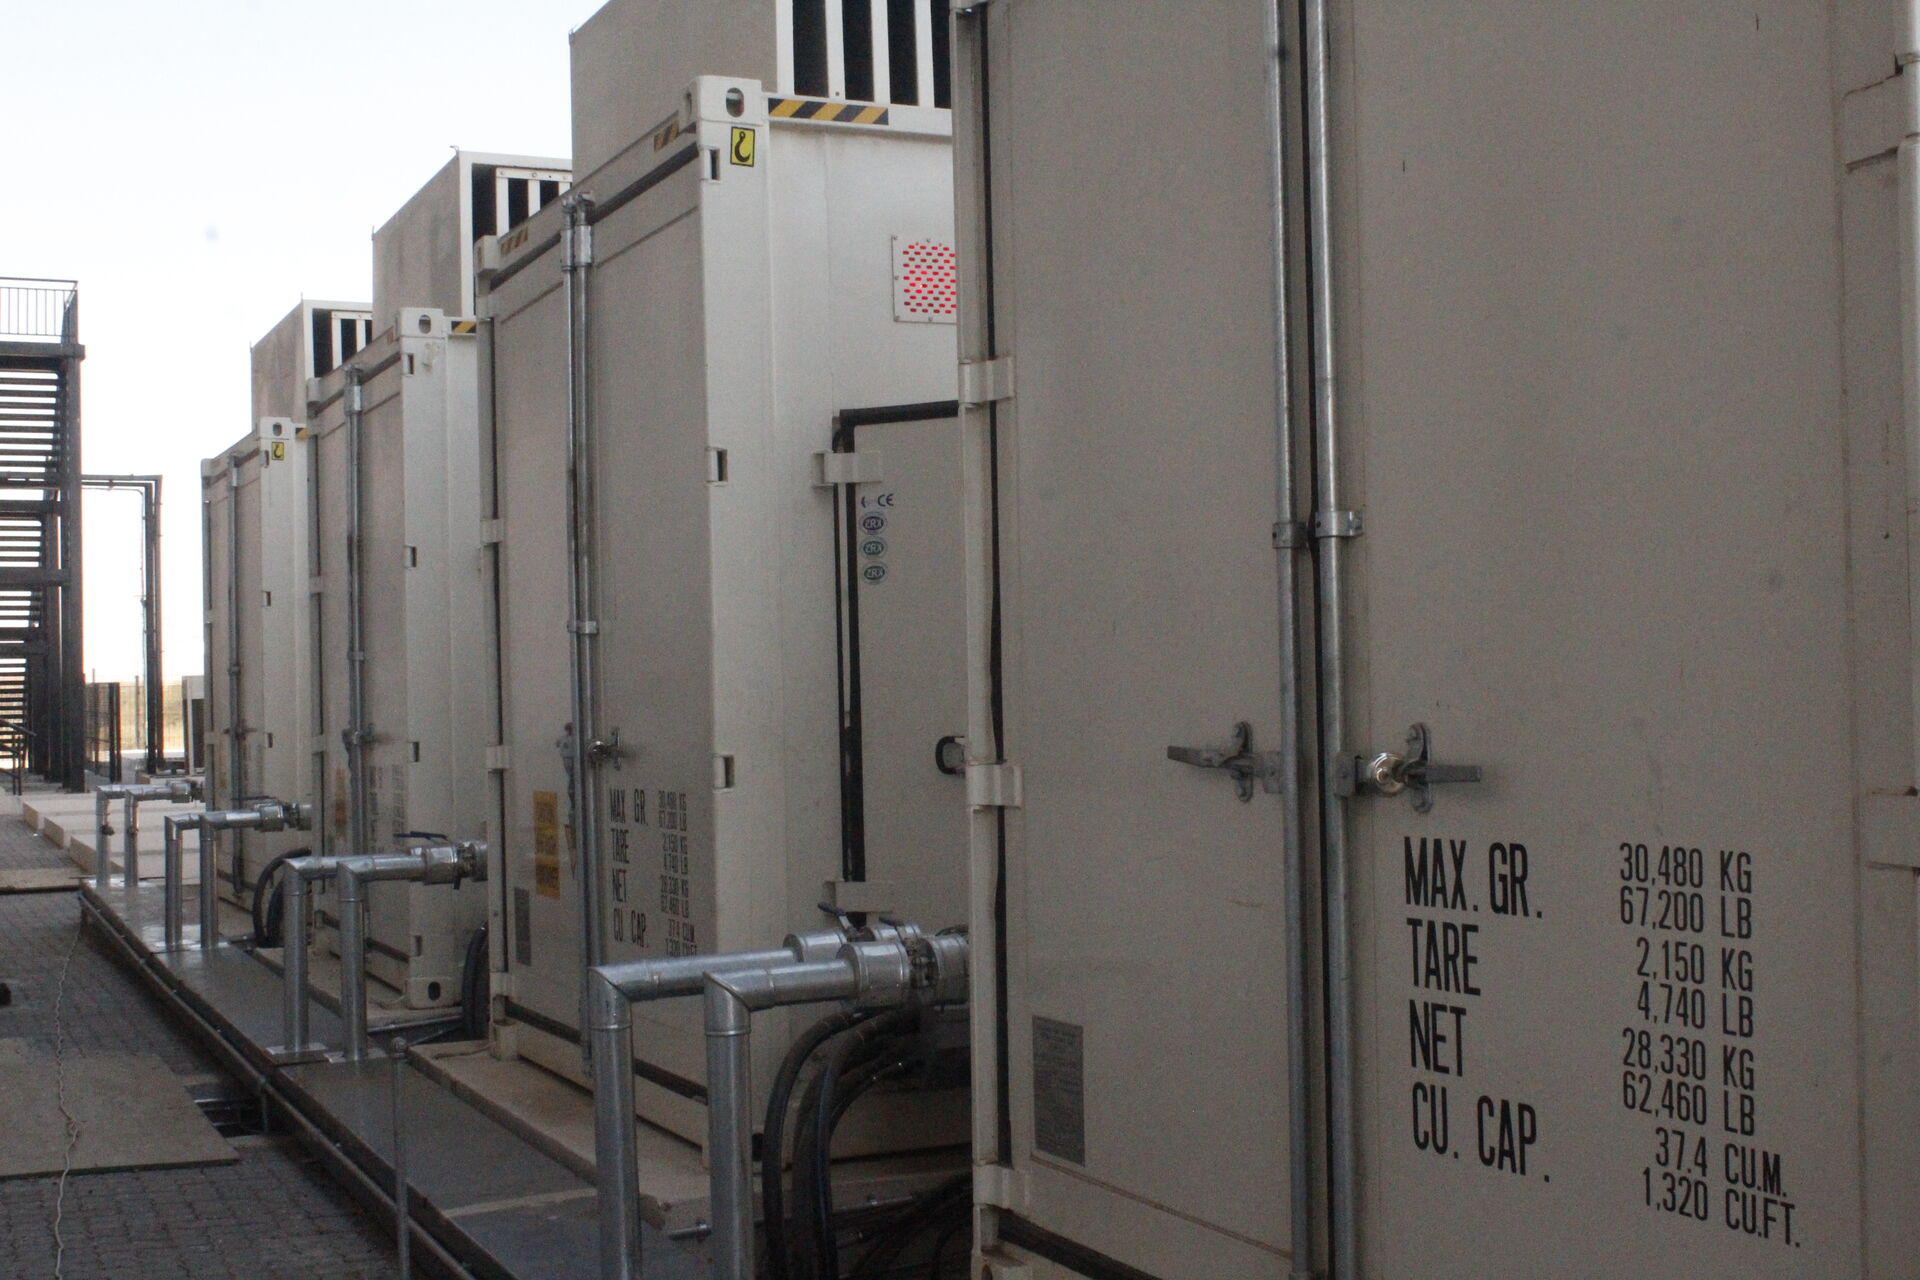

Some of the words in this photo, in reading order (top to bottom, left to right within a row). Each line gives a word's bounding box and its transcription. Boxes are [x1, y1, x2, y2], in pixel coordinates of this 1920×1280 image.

[877, 493, 894, 507] CE
[611, 828, 629, 864] TARE
[1620, 843, 1704, 889] 30,480
[1720, 850, 1752, 893] KG
[612, 868, 626, 902] NET
[1404, 836, 1479, 913] MAX.
[1489, 842, 1543, 919] GR.
[1620, 886, 1704, 933] 67,200
[1721, 896, 1752, 939] LB
[1406, 918, 1481, 996] TARE
[1636, 937, 1705, 985] 2,150
[1722, 947, 1753, 992] KG
[1637, 981, 1706, 1030] 4,740
[1722, 993, 1754, 1038] LB
[1409, 999, 1467, 1077] NET
[1622, 1027, 1706, 1081] 28,330
[1723, 1045, 1755, 1091] KG
[1623, 1072, 1707, 1126] 62,460
[1724, 1091, 1755, 1136] LB
[1412, 1082, 1459, 1160] CU.
[1477, 1095, 1550, 1183] CAP.
[1655, 1127, 1708, 1178] 37.4
[1643, 1167, 1708, 1221] 1,320
